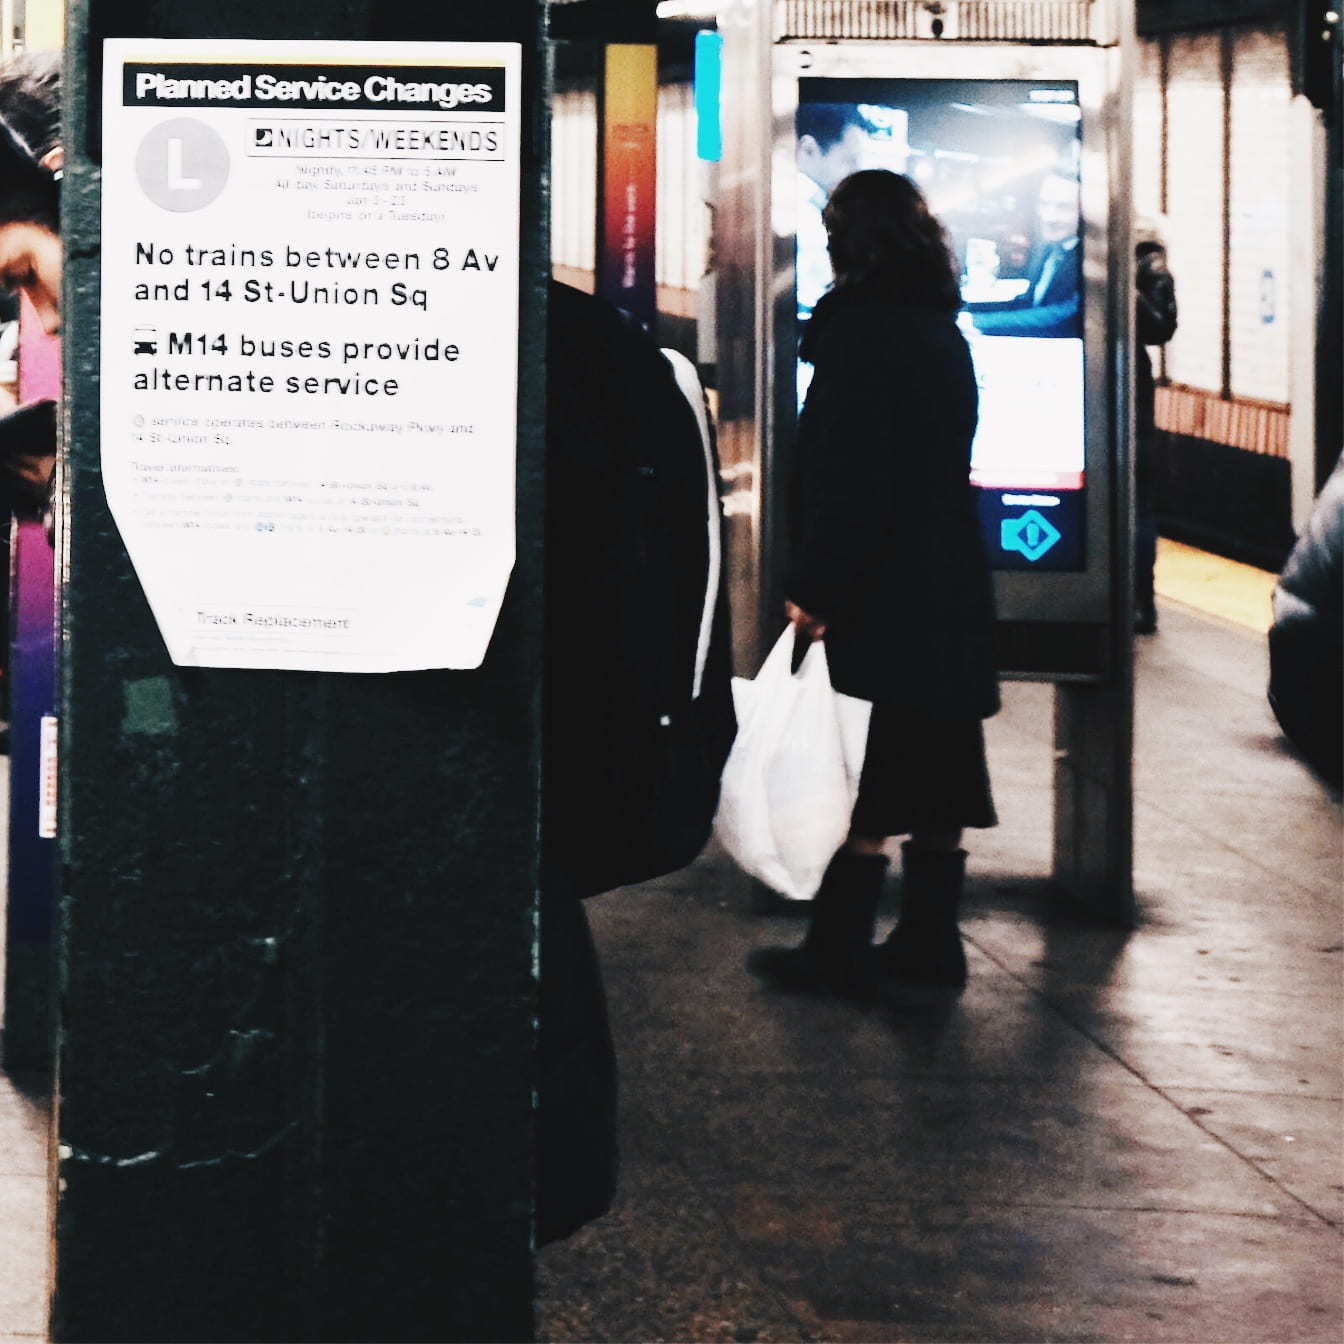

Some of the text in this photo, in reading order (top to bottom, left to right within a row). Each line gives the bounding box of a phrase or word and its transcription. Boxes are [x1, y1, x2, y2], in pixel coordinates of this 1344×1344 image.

[136, 72, 493, 109] Planned Service Changes
[277, 128, 498, 152] NIGHTS/WEEKENDS
[167, 137, 202, 190] L
[136, 242, 499, 271] No trains between 8 Av
[135, 278, 427, 311] and 14 St-Union Sq
[169, 332, 460, 364] M14 buses provide
[134, 367, 399, 396] alternate service
